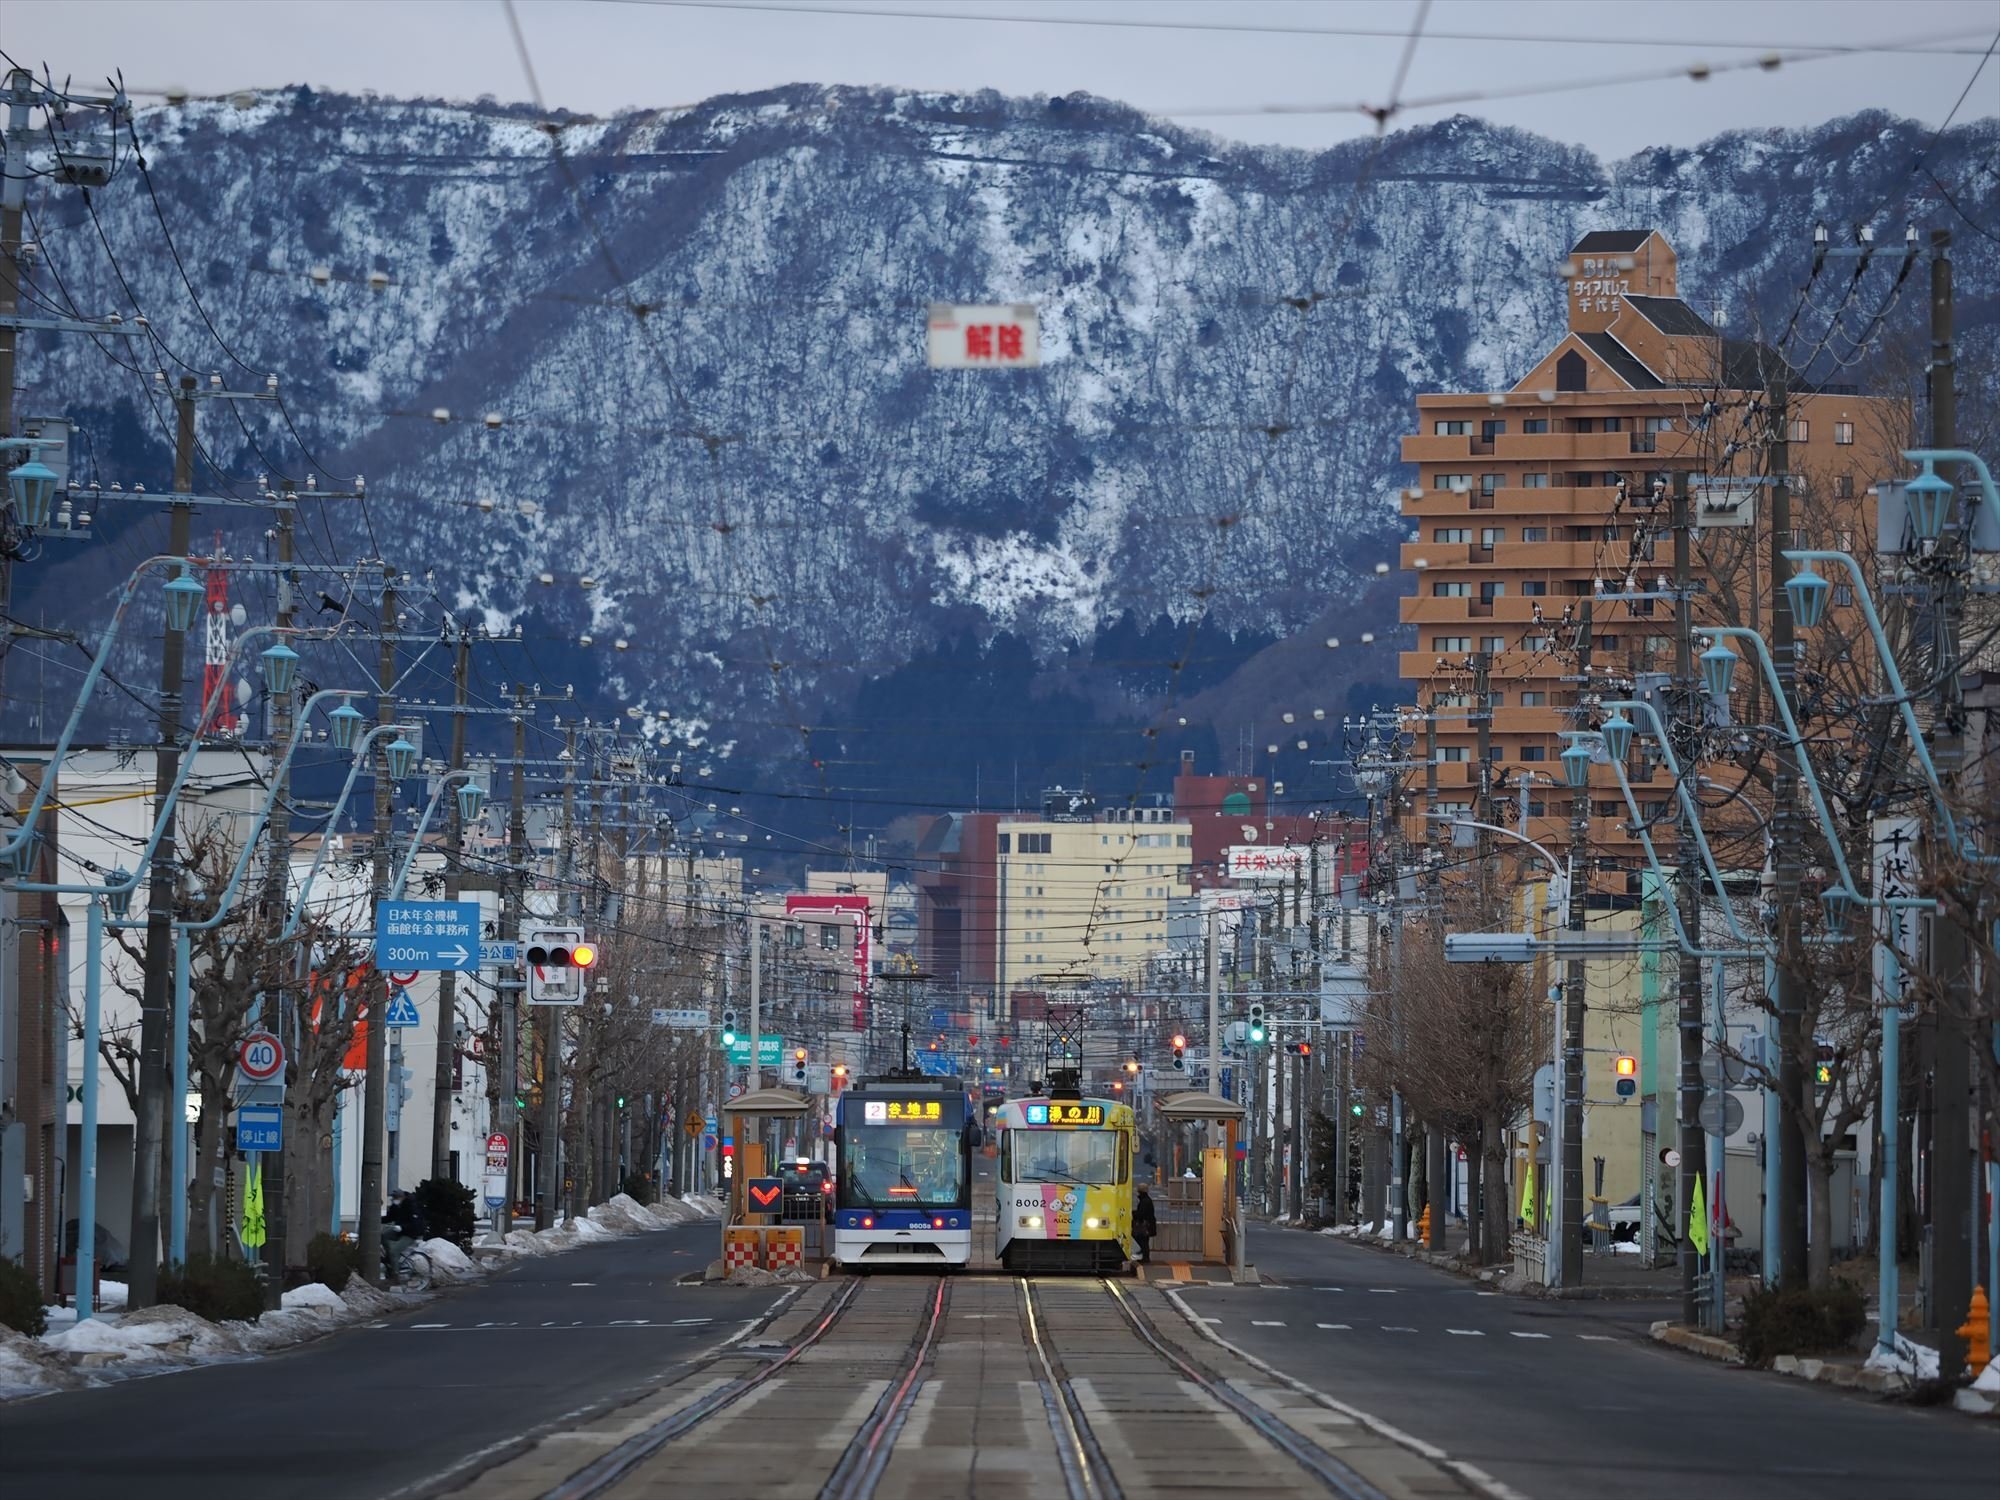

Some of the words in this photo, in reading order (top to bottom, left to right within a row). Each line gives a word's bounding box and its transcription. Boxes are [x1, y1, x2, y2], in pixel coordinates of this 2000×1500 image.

[1573, 279, 1629, 297] ダイアパレス
[966, 323, 1023, 360] 解除
[388, 909, 458, 922] 日本年金機構
[387, 923, 469, 937] 函館年金事務所
[388, 947, 429, 961] 300m
[249, 1046, 273, 1065] 40
[871, 1105, 880, 1117] 2
[1049, 1106, 1100, 1119] 湯の川
[241, 1130, 279, 1144] 停止線
[1015, 1199, 1047, 1208] 8002
